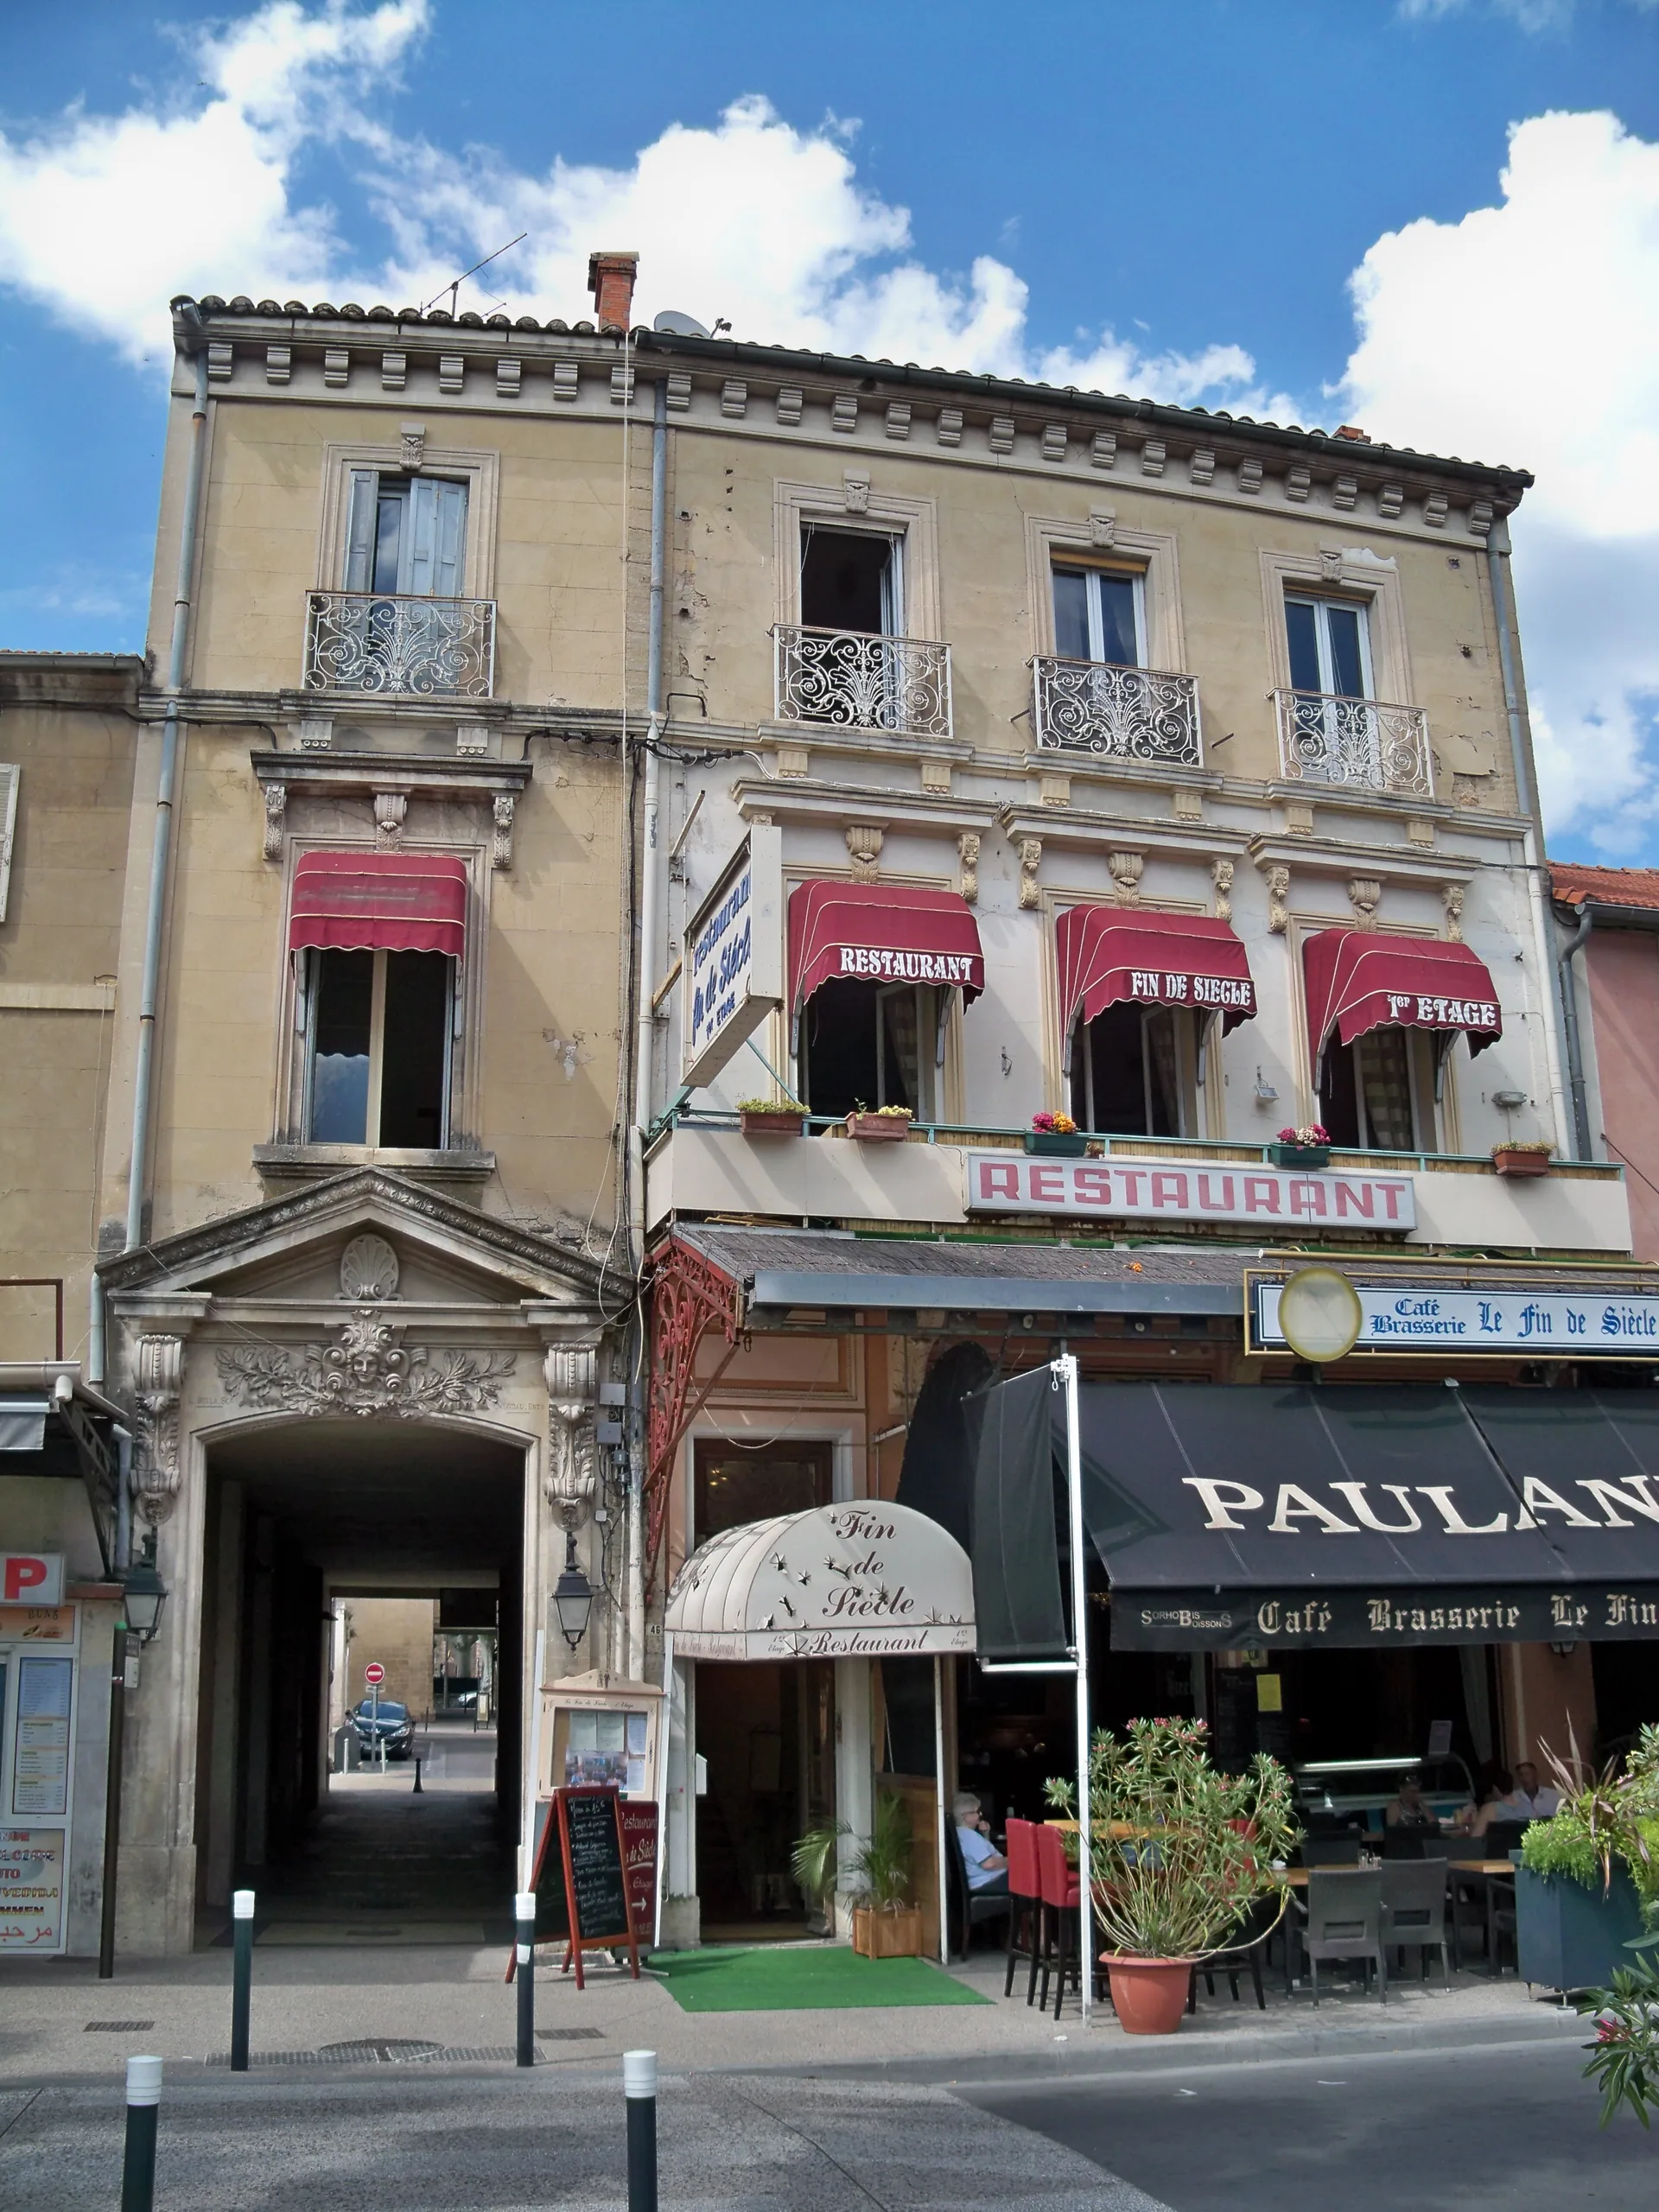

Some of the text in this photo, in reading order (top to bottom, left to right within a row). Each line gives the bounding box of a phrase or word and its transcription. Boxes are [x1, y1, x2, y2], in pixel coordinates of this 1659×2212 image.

[841, 947, 974, 982] RESTAURANT
[1131, 971, 1251, 1007] FIN DE SIECLE
[1387, 994, 1497, 1027] 1er ETAGE
[979, 1162, 1406, 1220] RESTAURANT
[1395, 1298, 1440, 1317] Café
[1477, 1301, 1657, 1339] Le Fin de Siècle
[1370, 1314, 1467, 1337] Brasserie
[1181, 1476, 1659, 1534] PAULAN
[835, 1510, 897, 1540] Fin
[4, 1558, 48, 1599] P
[854, 1551, 885, 1575] de
[651, 1626, 661, 1635] 46
[1257, 1594, 1657, 1634] Café Brasserie Le Fin
[809, 1630, 930, 1654] Restaurant
